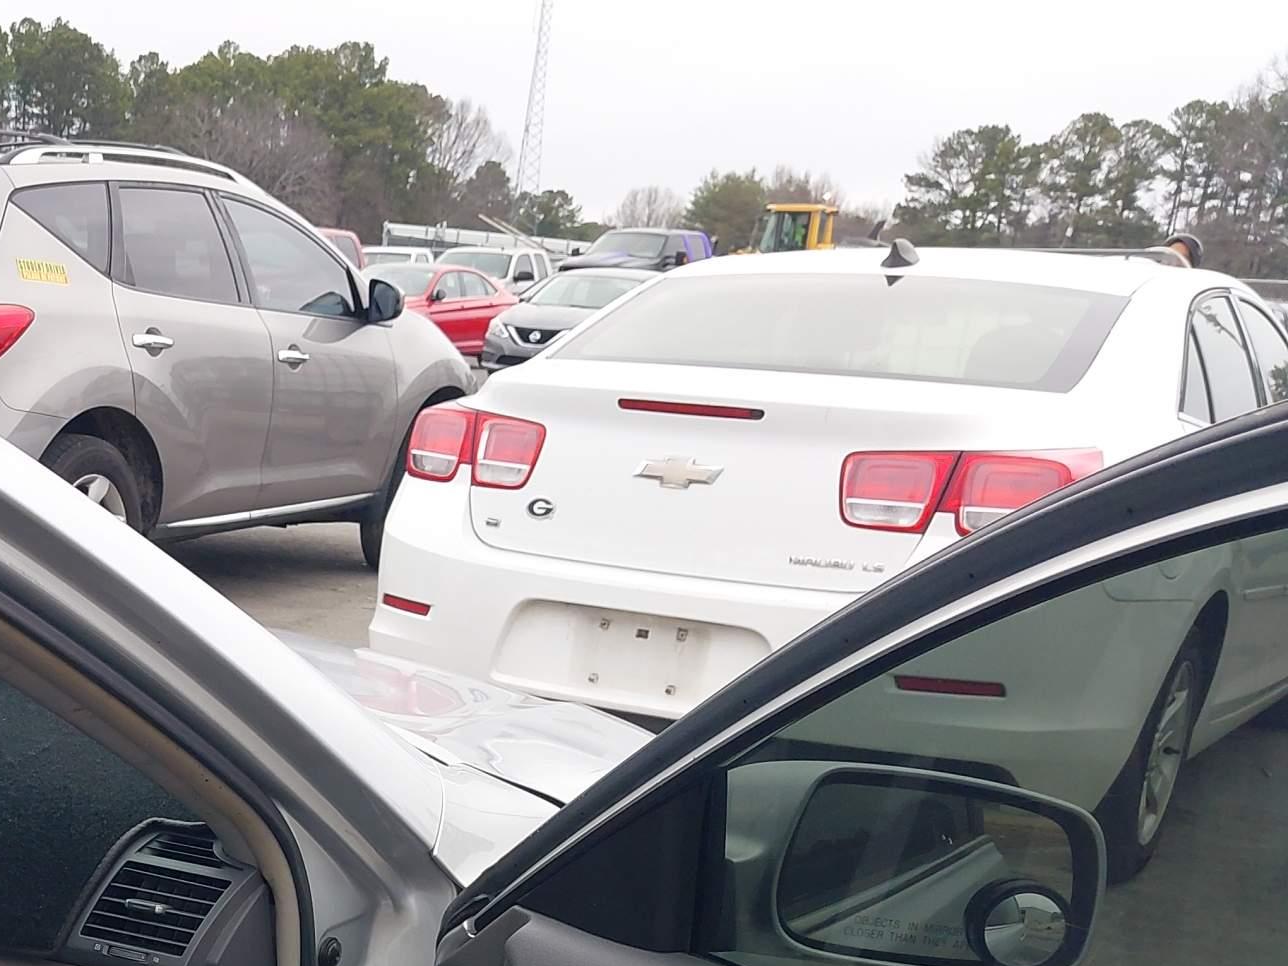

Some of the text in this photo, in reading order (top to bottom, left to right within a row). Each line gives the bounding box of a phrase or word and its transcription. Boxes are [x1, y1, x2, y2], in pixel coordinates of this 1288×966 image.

[527, 498, 554, 517] G
[854, 914, 901, 929] OBJECTS
[907, 921, 919, 931] IN
[843, 926, 884, 939] CLOSER
[889, 931, 916, 944] THAN
